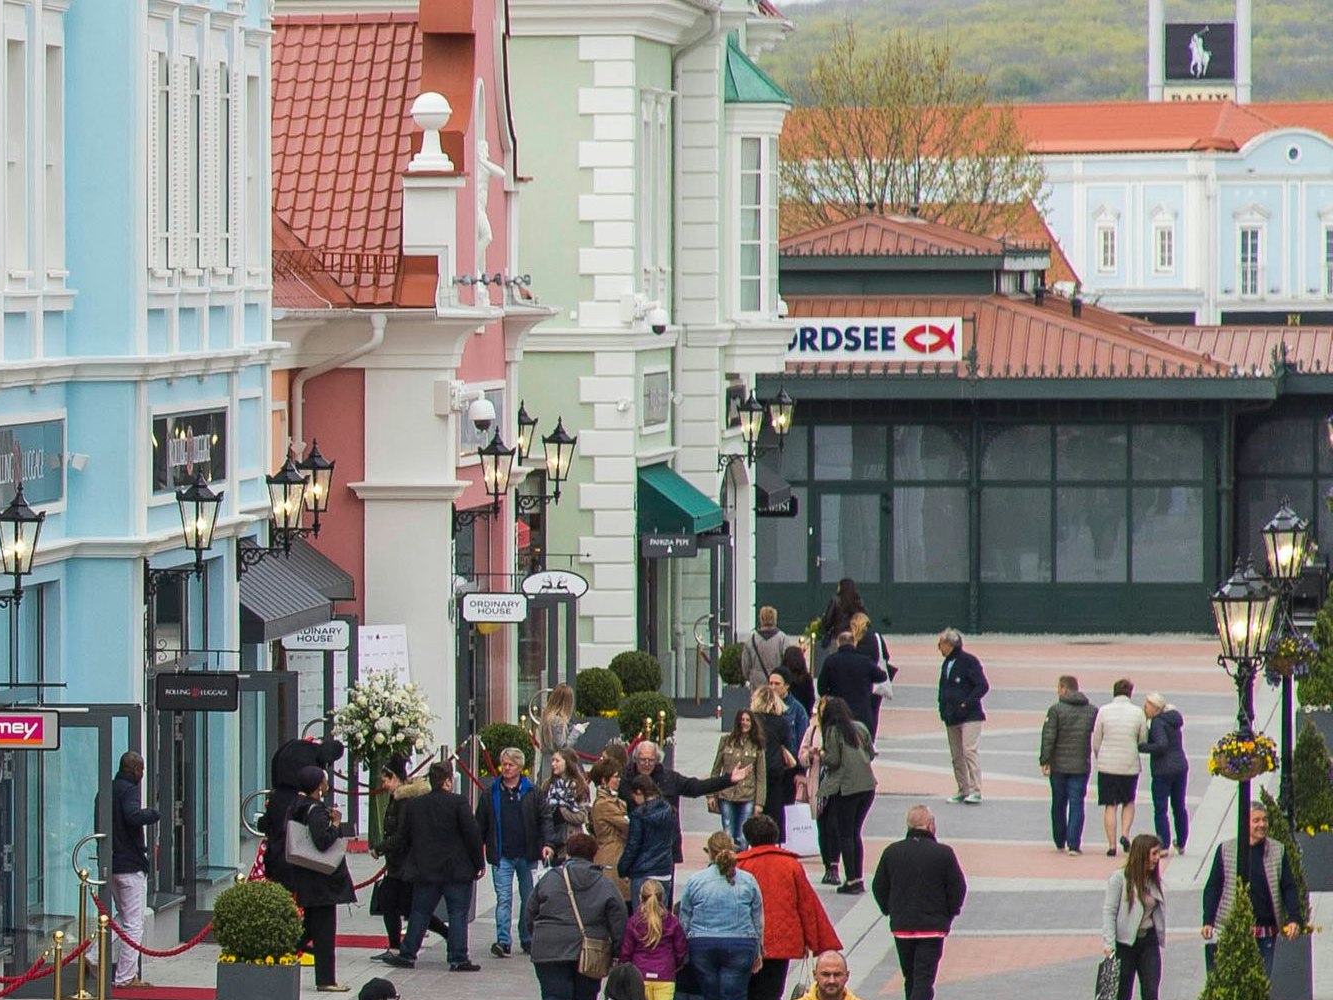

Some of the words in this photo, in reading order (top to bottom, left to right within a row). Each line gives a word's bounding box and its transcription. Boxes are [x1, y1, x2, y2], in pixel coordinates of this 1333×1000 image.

[788, 326, 896, 352] RDSEE
[469, 600, 520, 608] ORDINARY
[296, 635, 334, 643] HOUSE
